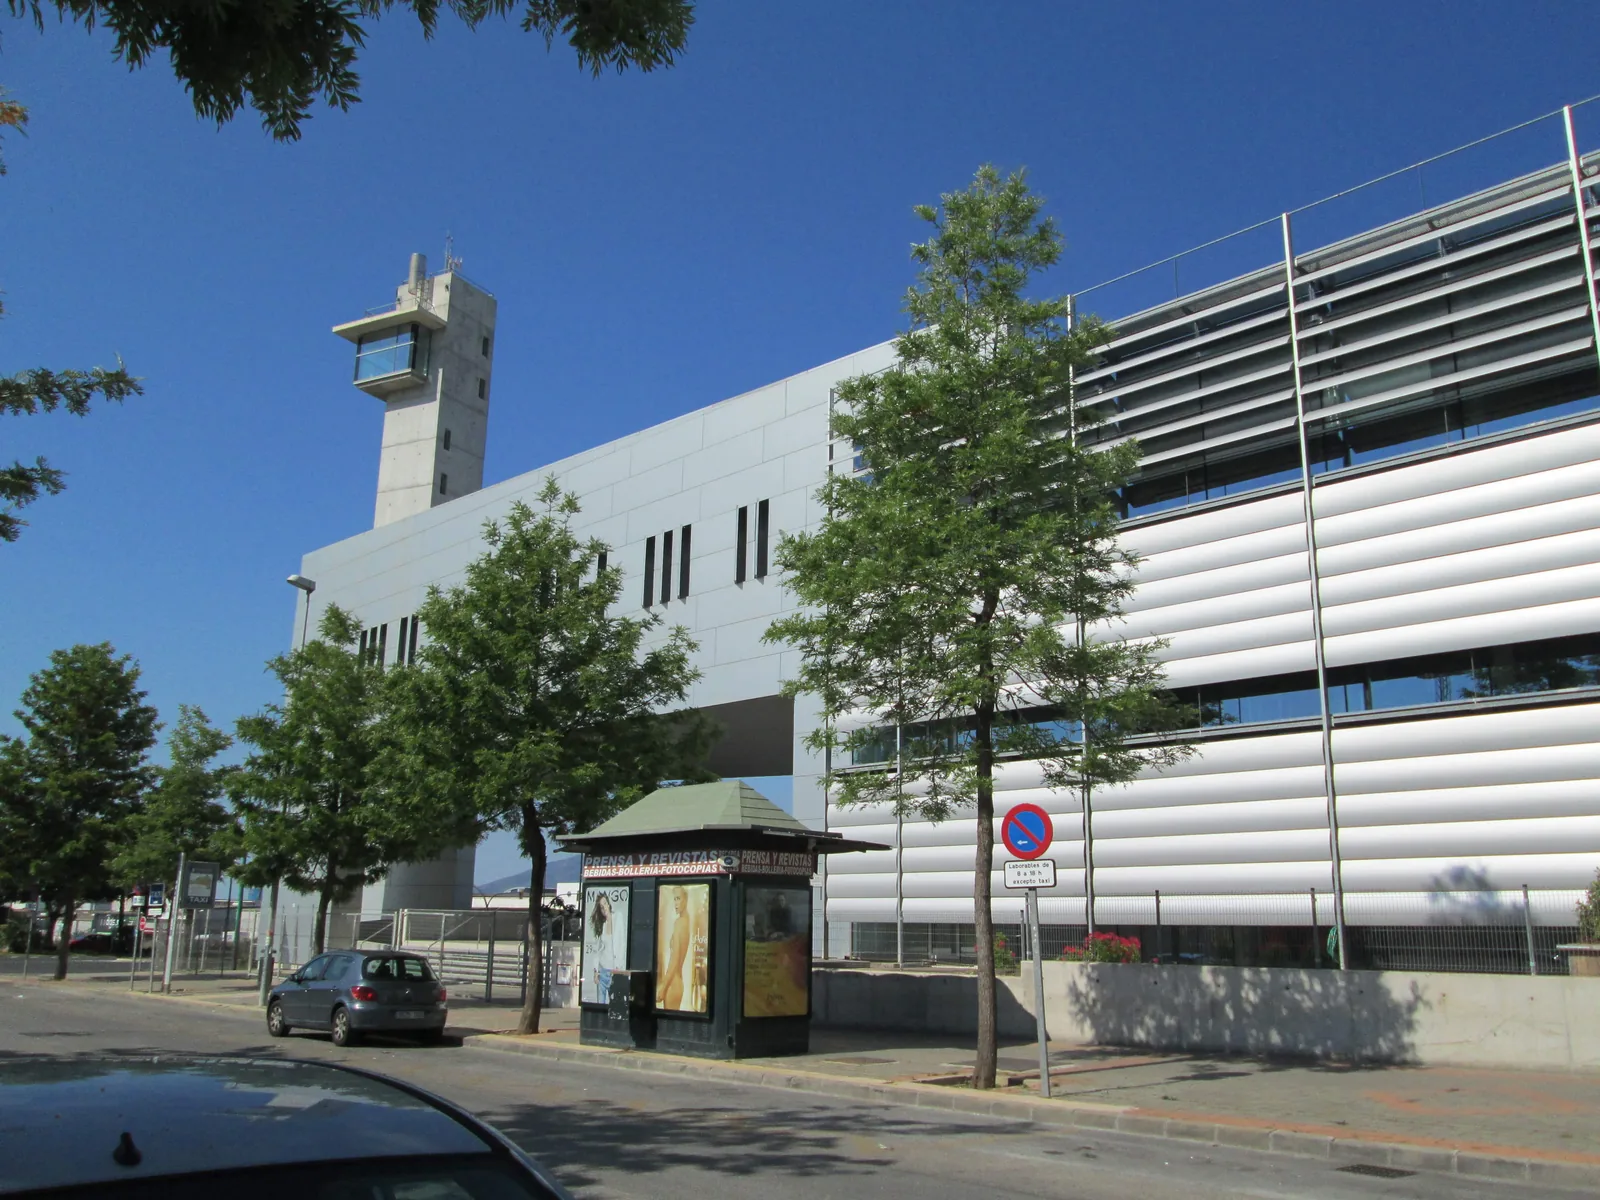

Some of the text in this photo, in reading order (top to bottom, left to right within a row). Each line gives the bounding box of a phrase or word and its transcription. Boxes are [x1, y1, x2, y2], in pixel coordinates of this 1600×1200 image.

[584, 849, 719, 869] PRENSA Y REVISTAS
[742, 850, 813, 867] PRENSA Y REVISTAS
